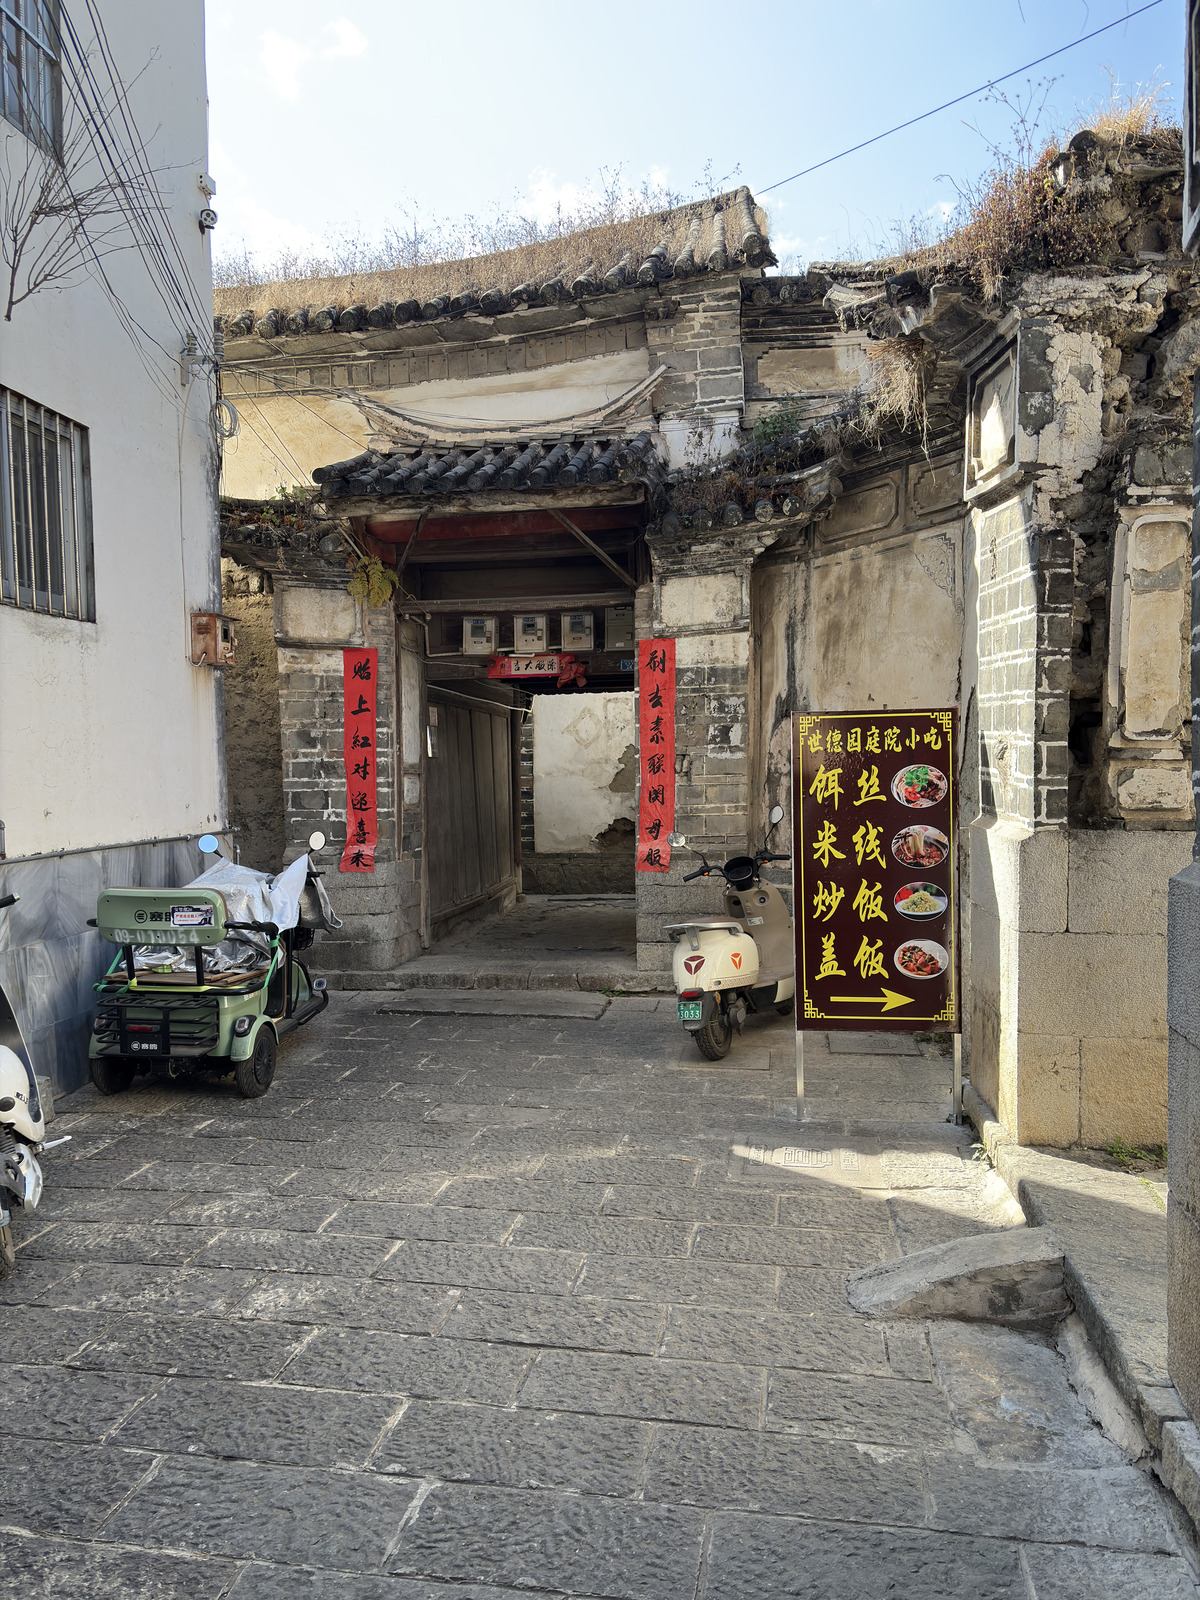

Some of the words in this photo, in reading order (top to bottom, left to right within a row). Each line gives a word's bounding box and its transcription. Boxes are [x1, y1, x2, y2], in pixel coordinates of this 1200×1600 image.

[807, 726, 943, 754] 世德园庭院小吃
[809, 764, 887, 811] 饵丝
[812, 820, 887, 869] 米线
[812, 878, 889, 923] 炒饭
[814, 931, 890, 981] 盖饭
